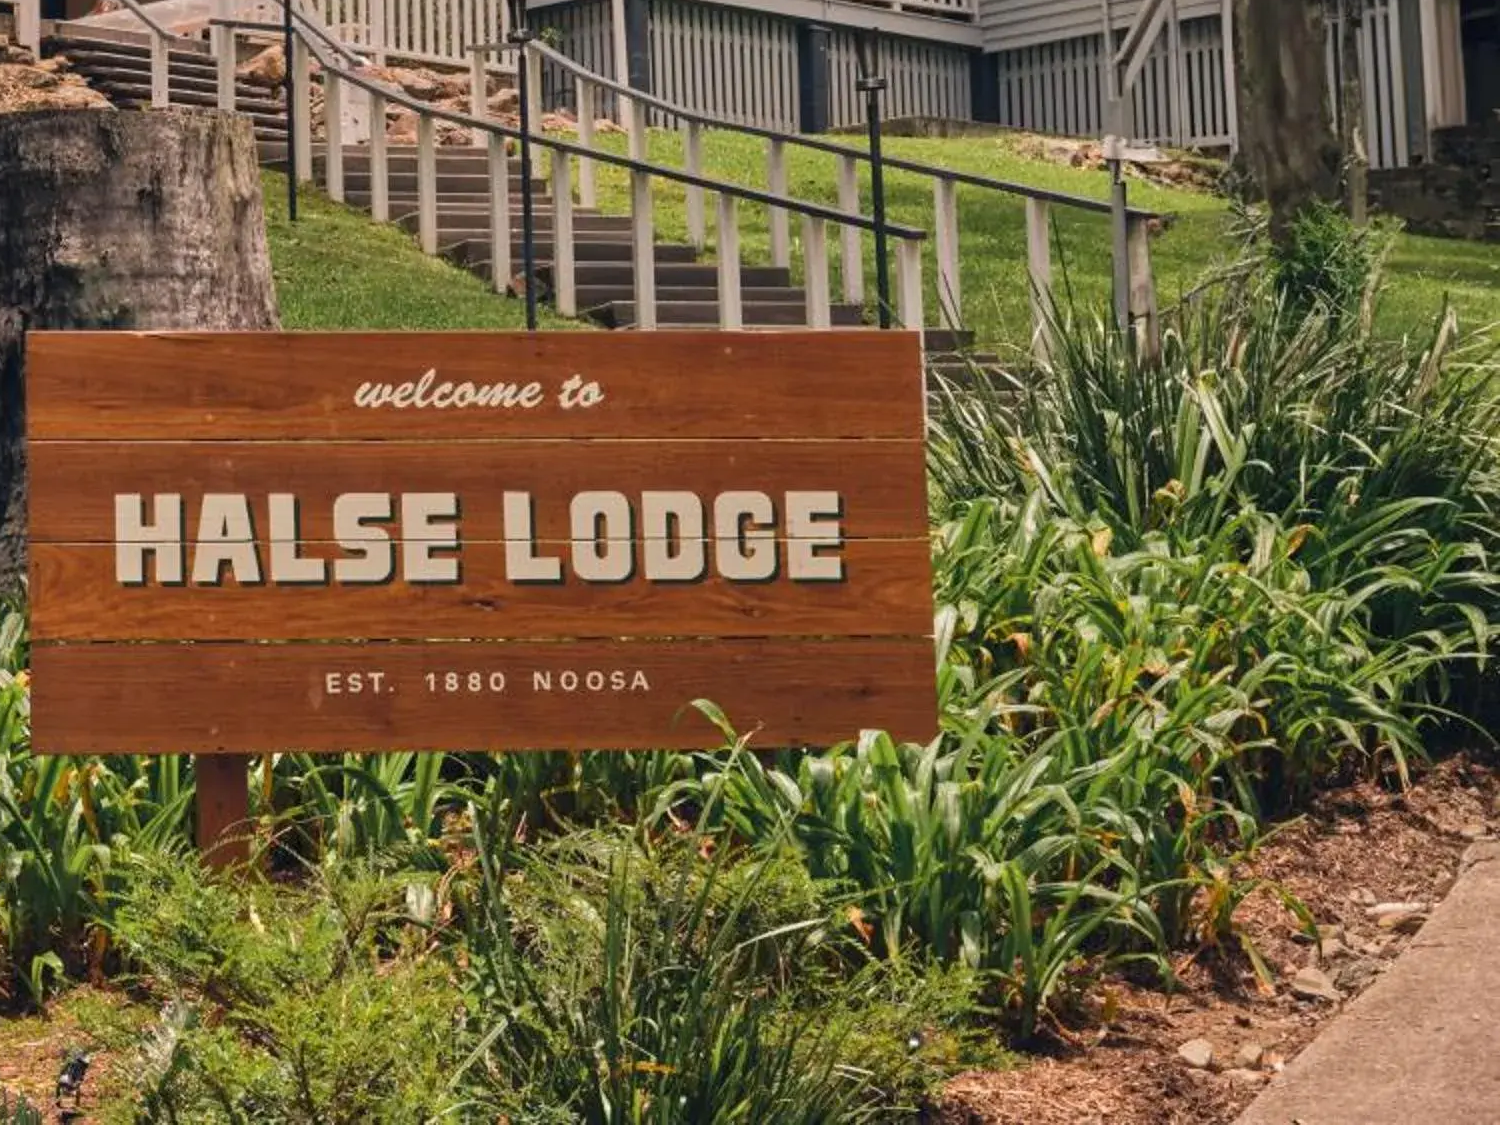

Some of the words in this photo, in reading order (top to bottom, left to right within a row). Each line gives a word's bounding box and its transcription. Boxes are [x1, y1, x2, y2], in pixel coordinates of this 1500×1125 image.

[353, 368, 544, 408] welcome
[558, 374, 605, 409] to
[114, 492, 460, 584] HALSE
[503, 490, 845, 582] LODGE
[325, 672, 396, 693] EST.
[425, 671, 506, 692] 1880
[532, 670, 651, 691] NOOSA
